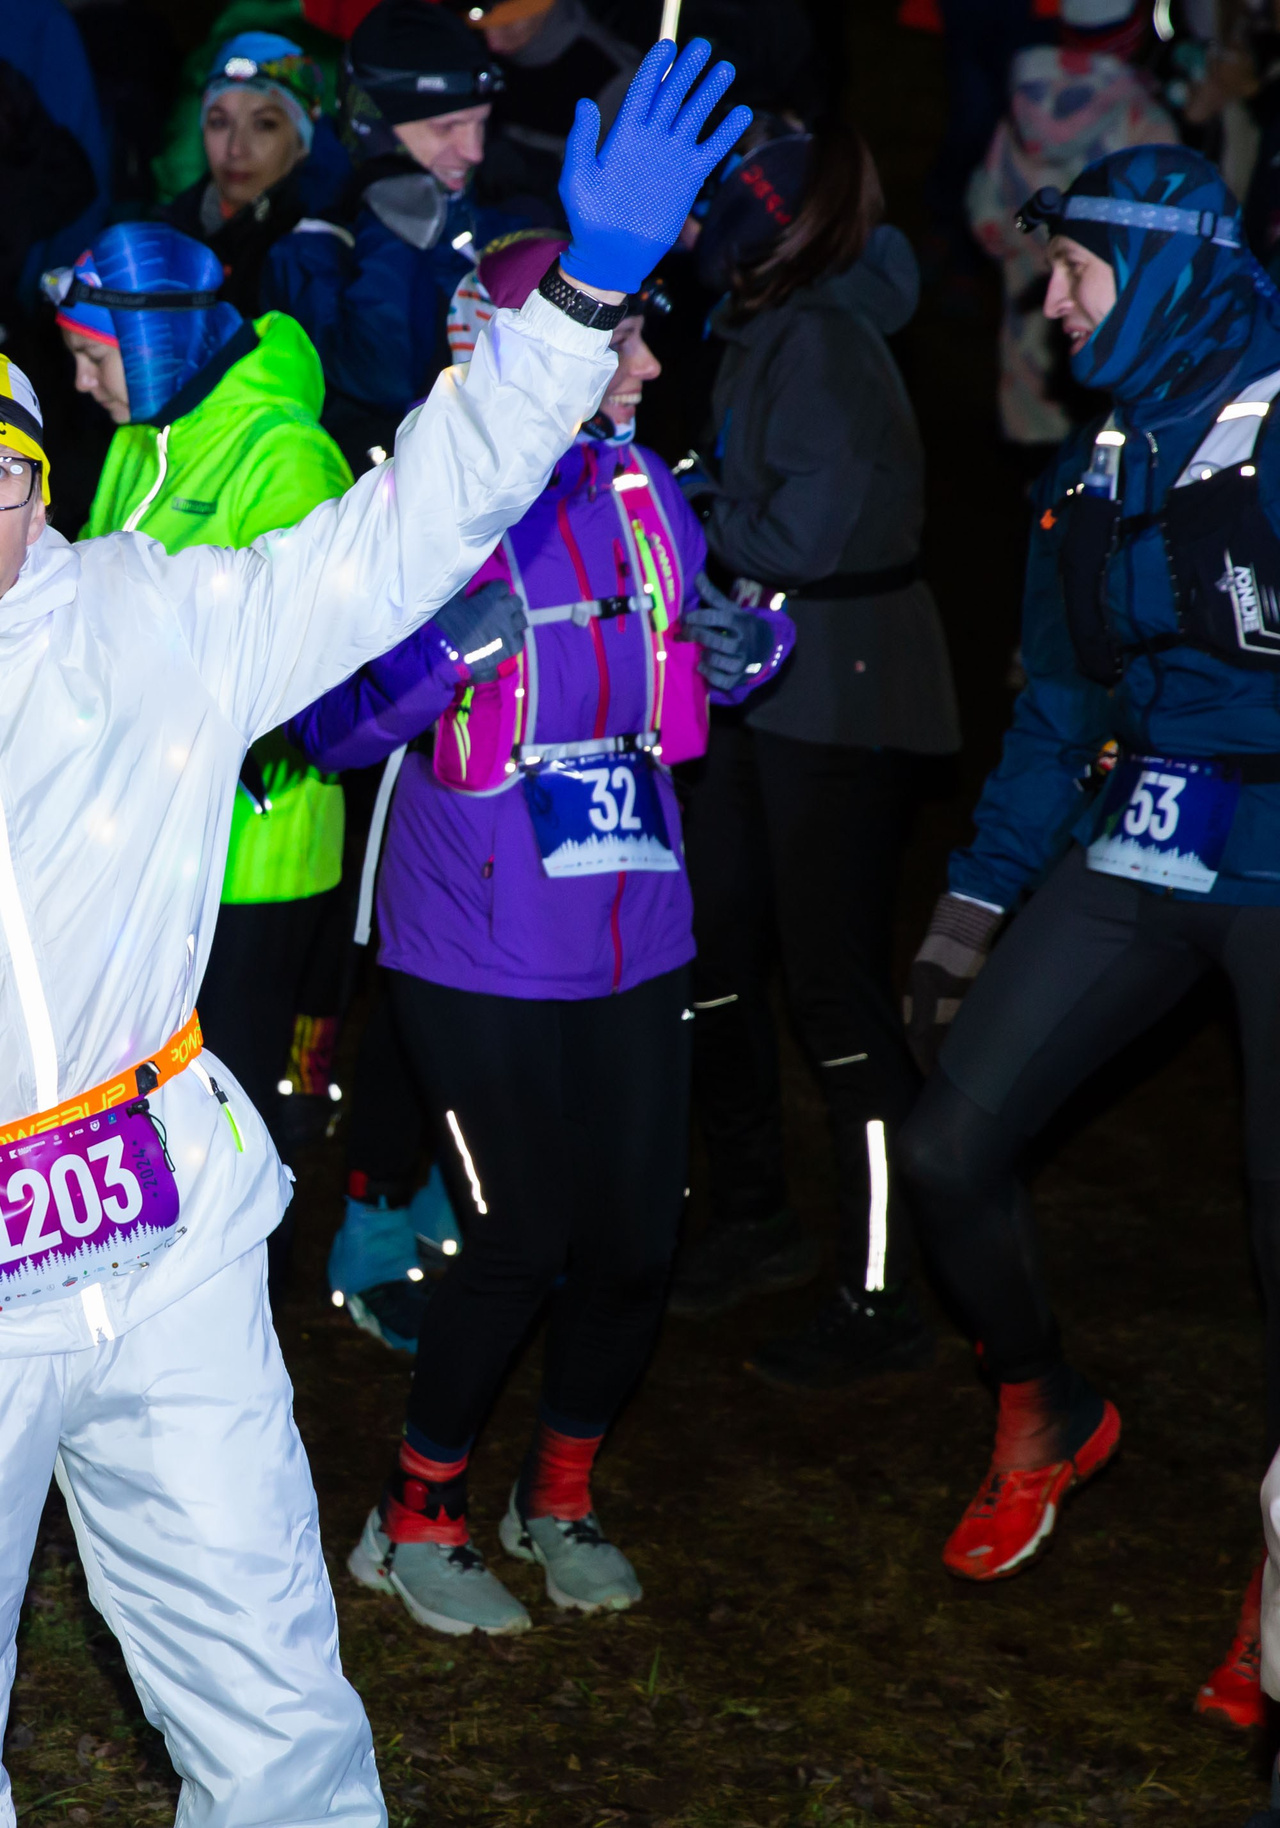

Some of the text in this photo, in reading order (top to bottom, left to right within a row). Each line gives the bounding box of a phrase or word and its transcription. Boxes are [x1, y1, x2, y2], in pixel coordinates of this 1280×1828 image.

[581, 765, 642, 832] 32
[1123, 770, 1187, 842] 53
[133, 1147, 159, 1191] 2024
